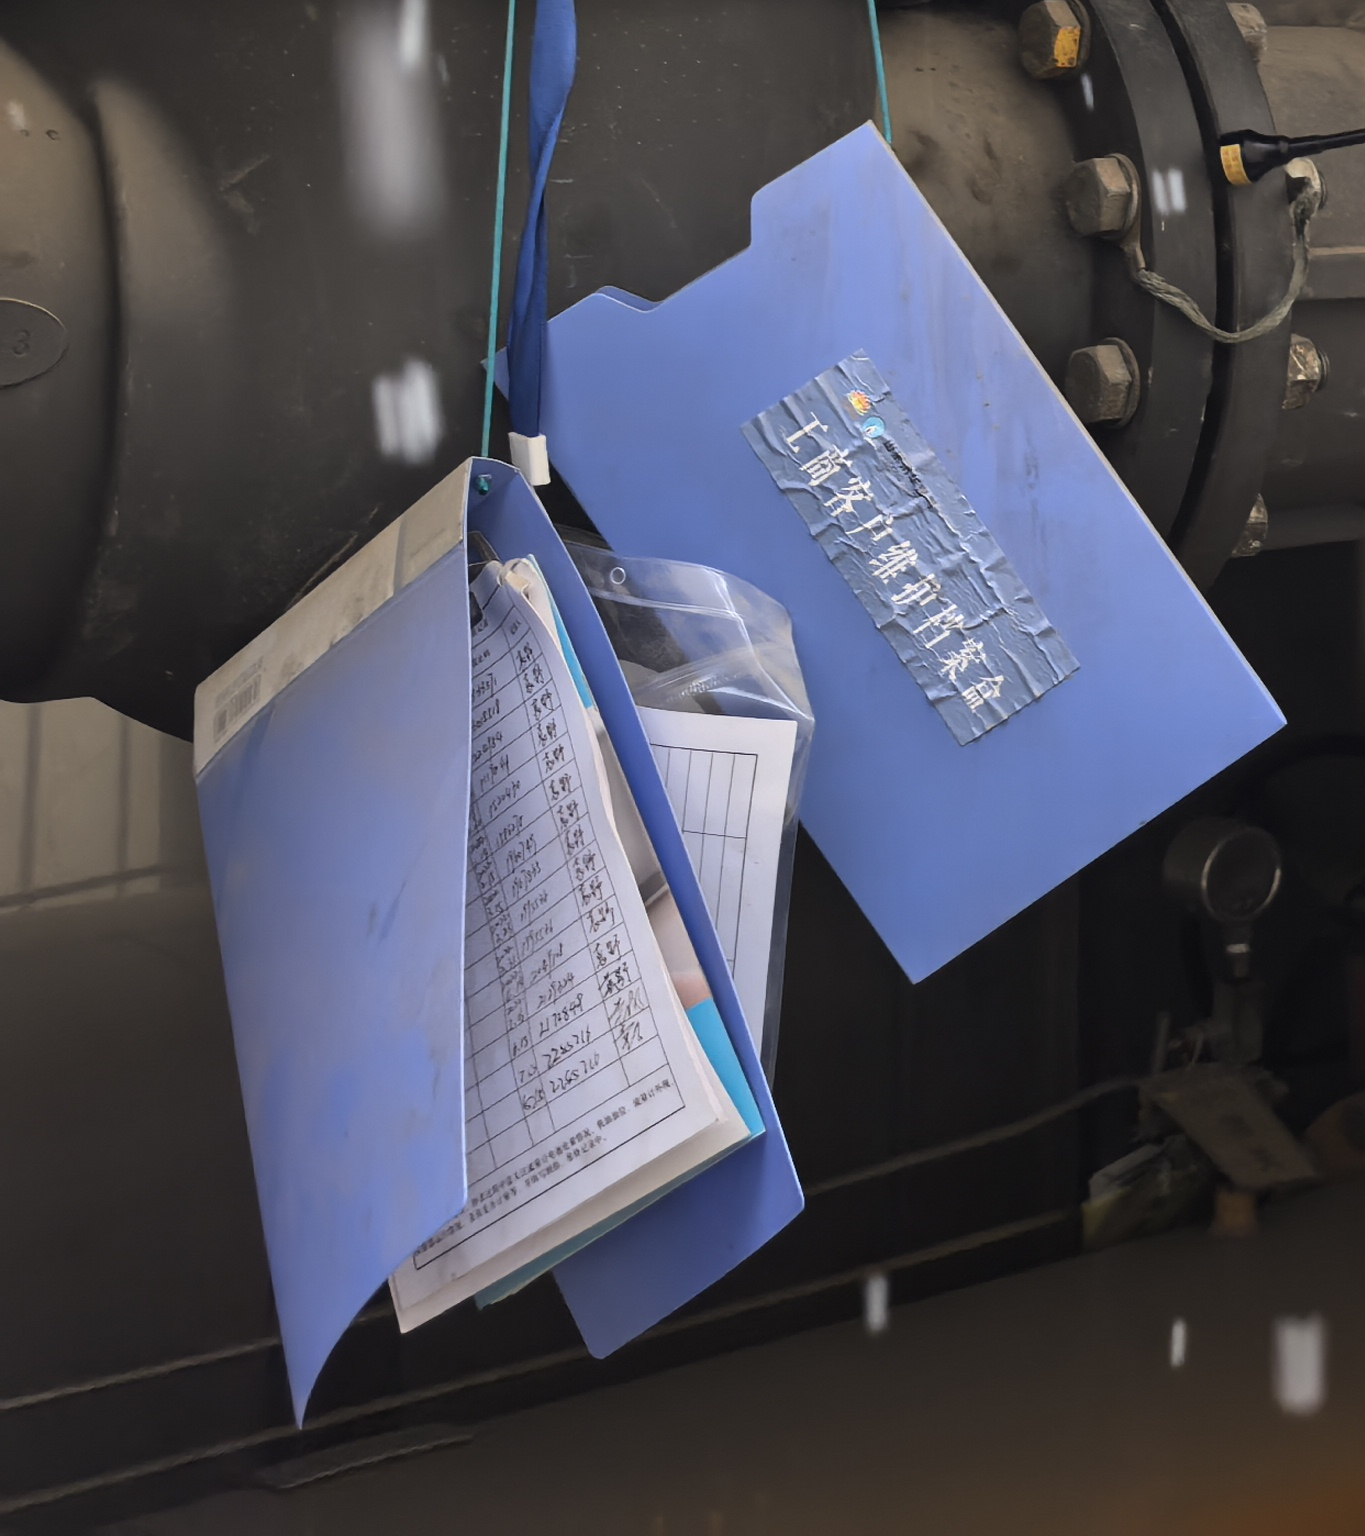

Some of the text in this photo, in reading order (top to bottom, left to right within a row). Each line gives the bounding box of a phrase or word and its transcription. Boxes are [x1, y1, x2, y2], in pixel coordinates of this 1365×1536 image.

[783, 411, 1008, 712] 工商客户维护档案盒
